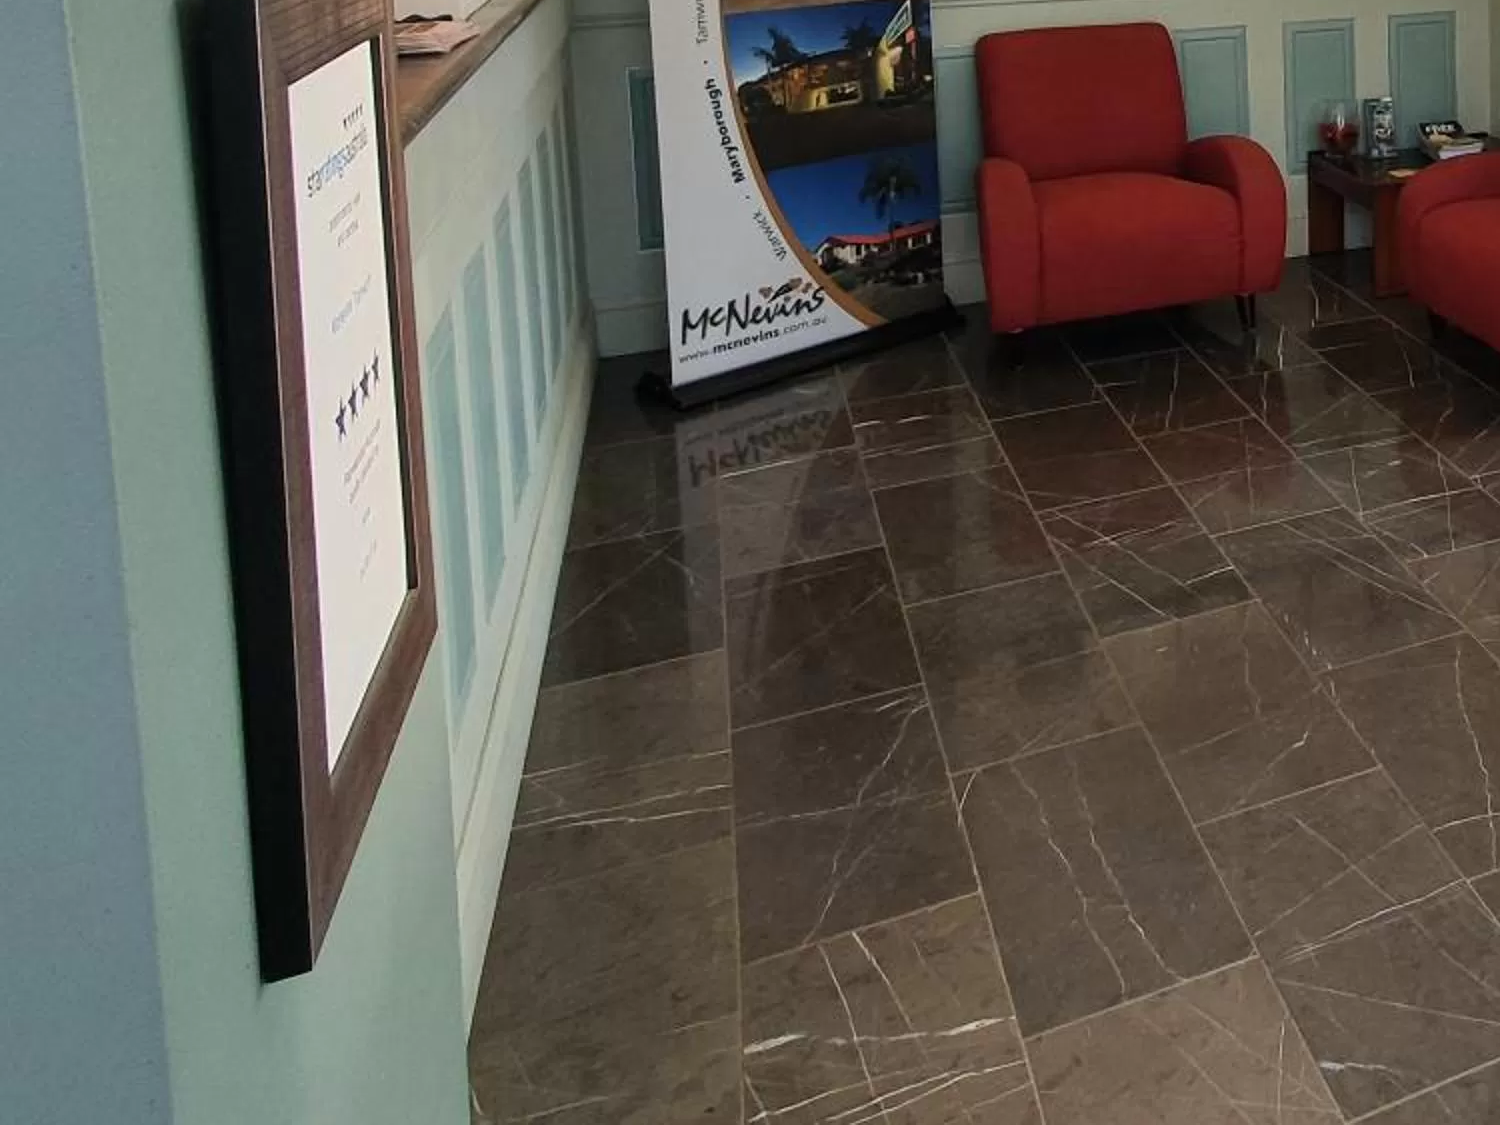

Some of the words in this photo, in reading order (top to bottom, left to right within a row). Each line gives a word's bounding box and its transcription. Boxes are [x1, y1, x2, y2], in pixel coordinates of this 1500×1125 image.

[704, 78, 746, 184] Maryborough
[752, 210, 788, 261] Warwick
[679, 316, 828, 363] www.mcnevins.com.au
